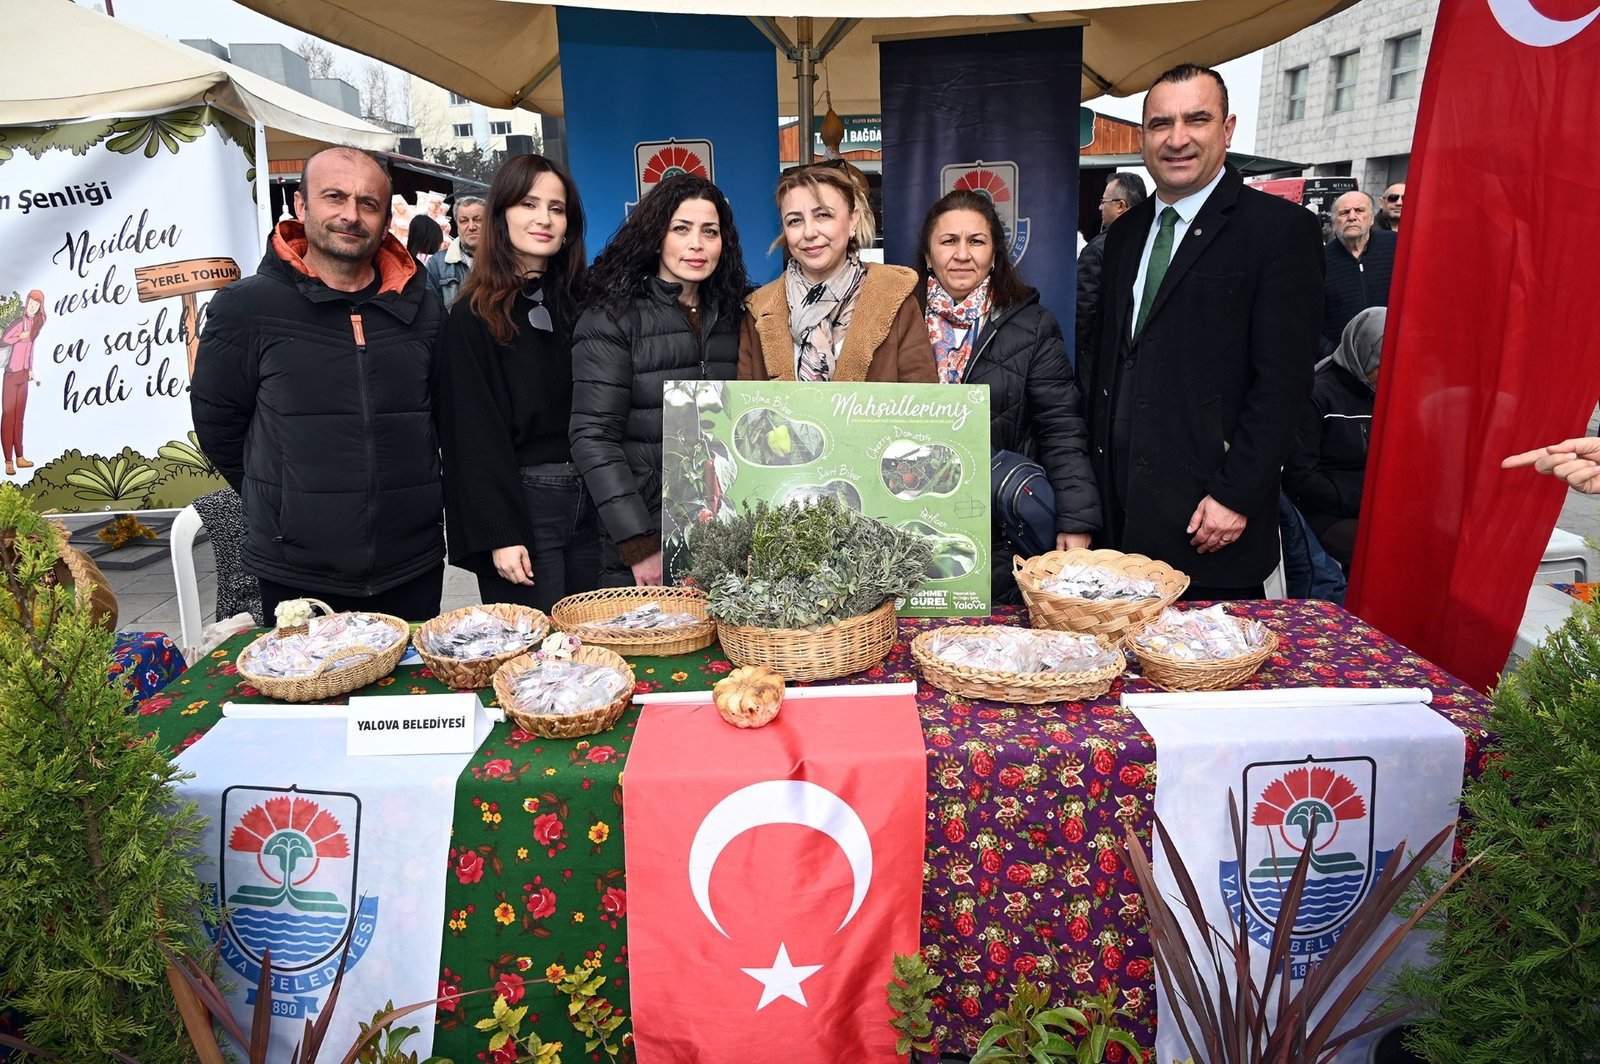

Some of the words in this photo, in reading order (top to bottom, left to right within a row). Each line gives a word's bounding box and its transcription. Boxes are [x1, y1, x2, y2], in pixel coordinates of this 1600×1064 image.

[17, 180, 113, 214] Şenliği
[52, 208, 182, 278] Nesilden
[54, 264, 132, 316] nesile
[150, 274, 189, 289] YEREL
[191, 267, 237, 283] TOHUM
[52, 338, 90, 364] en
[103, 300, 208, 366] sağlıkl
[63, 364, 133, 413] hali
[831, 392, 972, 431] Mahsüllerimiz
[865, 434, 893, 460] Cherry
[953, 600, 986, 610] Yalova
[357, 719, 400, 732] YALOVA
[402, 715, 466, 730] BELEDİYESİ
[210, 926, 248, 974] LOVA
[272, 1001, 297, 1016] 890
